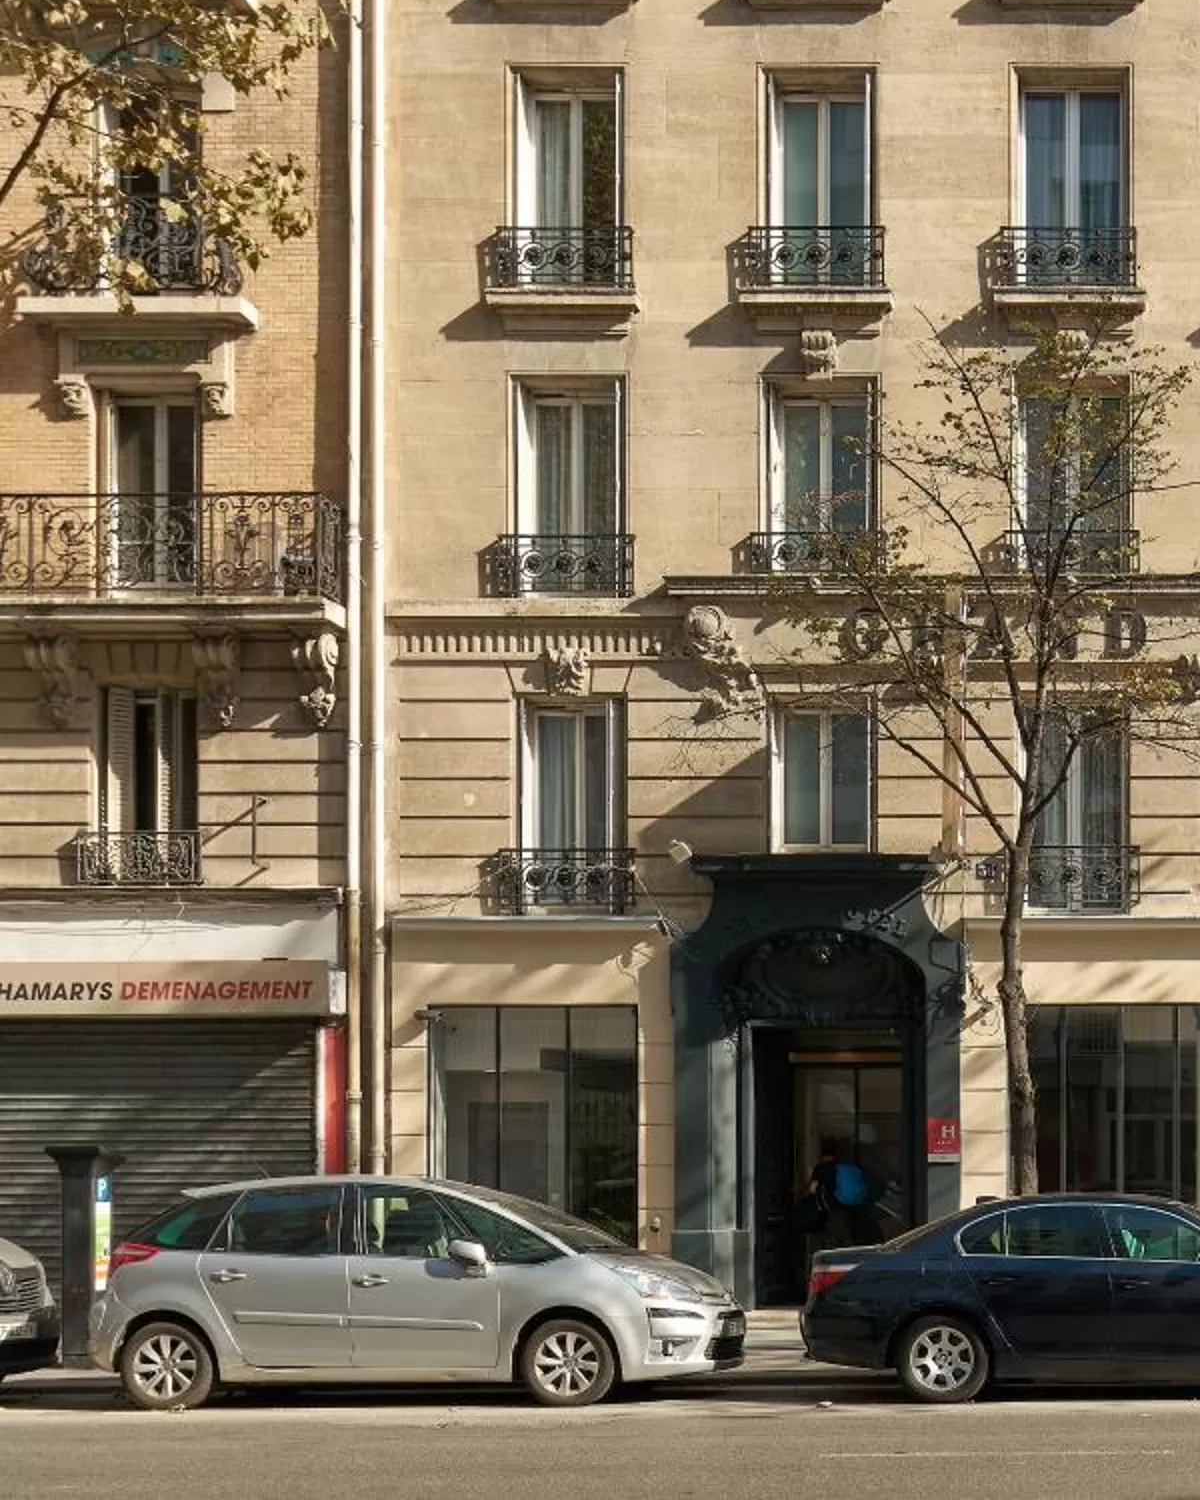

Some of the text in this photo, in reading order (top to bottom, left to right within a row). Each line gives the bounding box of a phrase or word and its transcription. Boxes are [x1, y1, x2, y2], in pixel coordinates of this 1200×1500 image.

[0, 981, 313, 1001] HAMARYS DEMENAGEMENT
[941, 1125, 955, 1138] H
[97, 1177, 107, 1198] P
